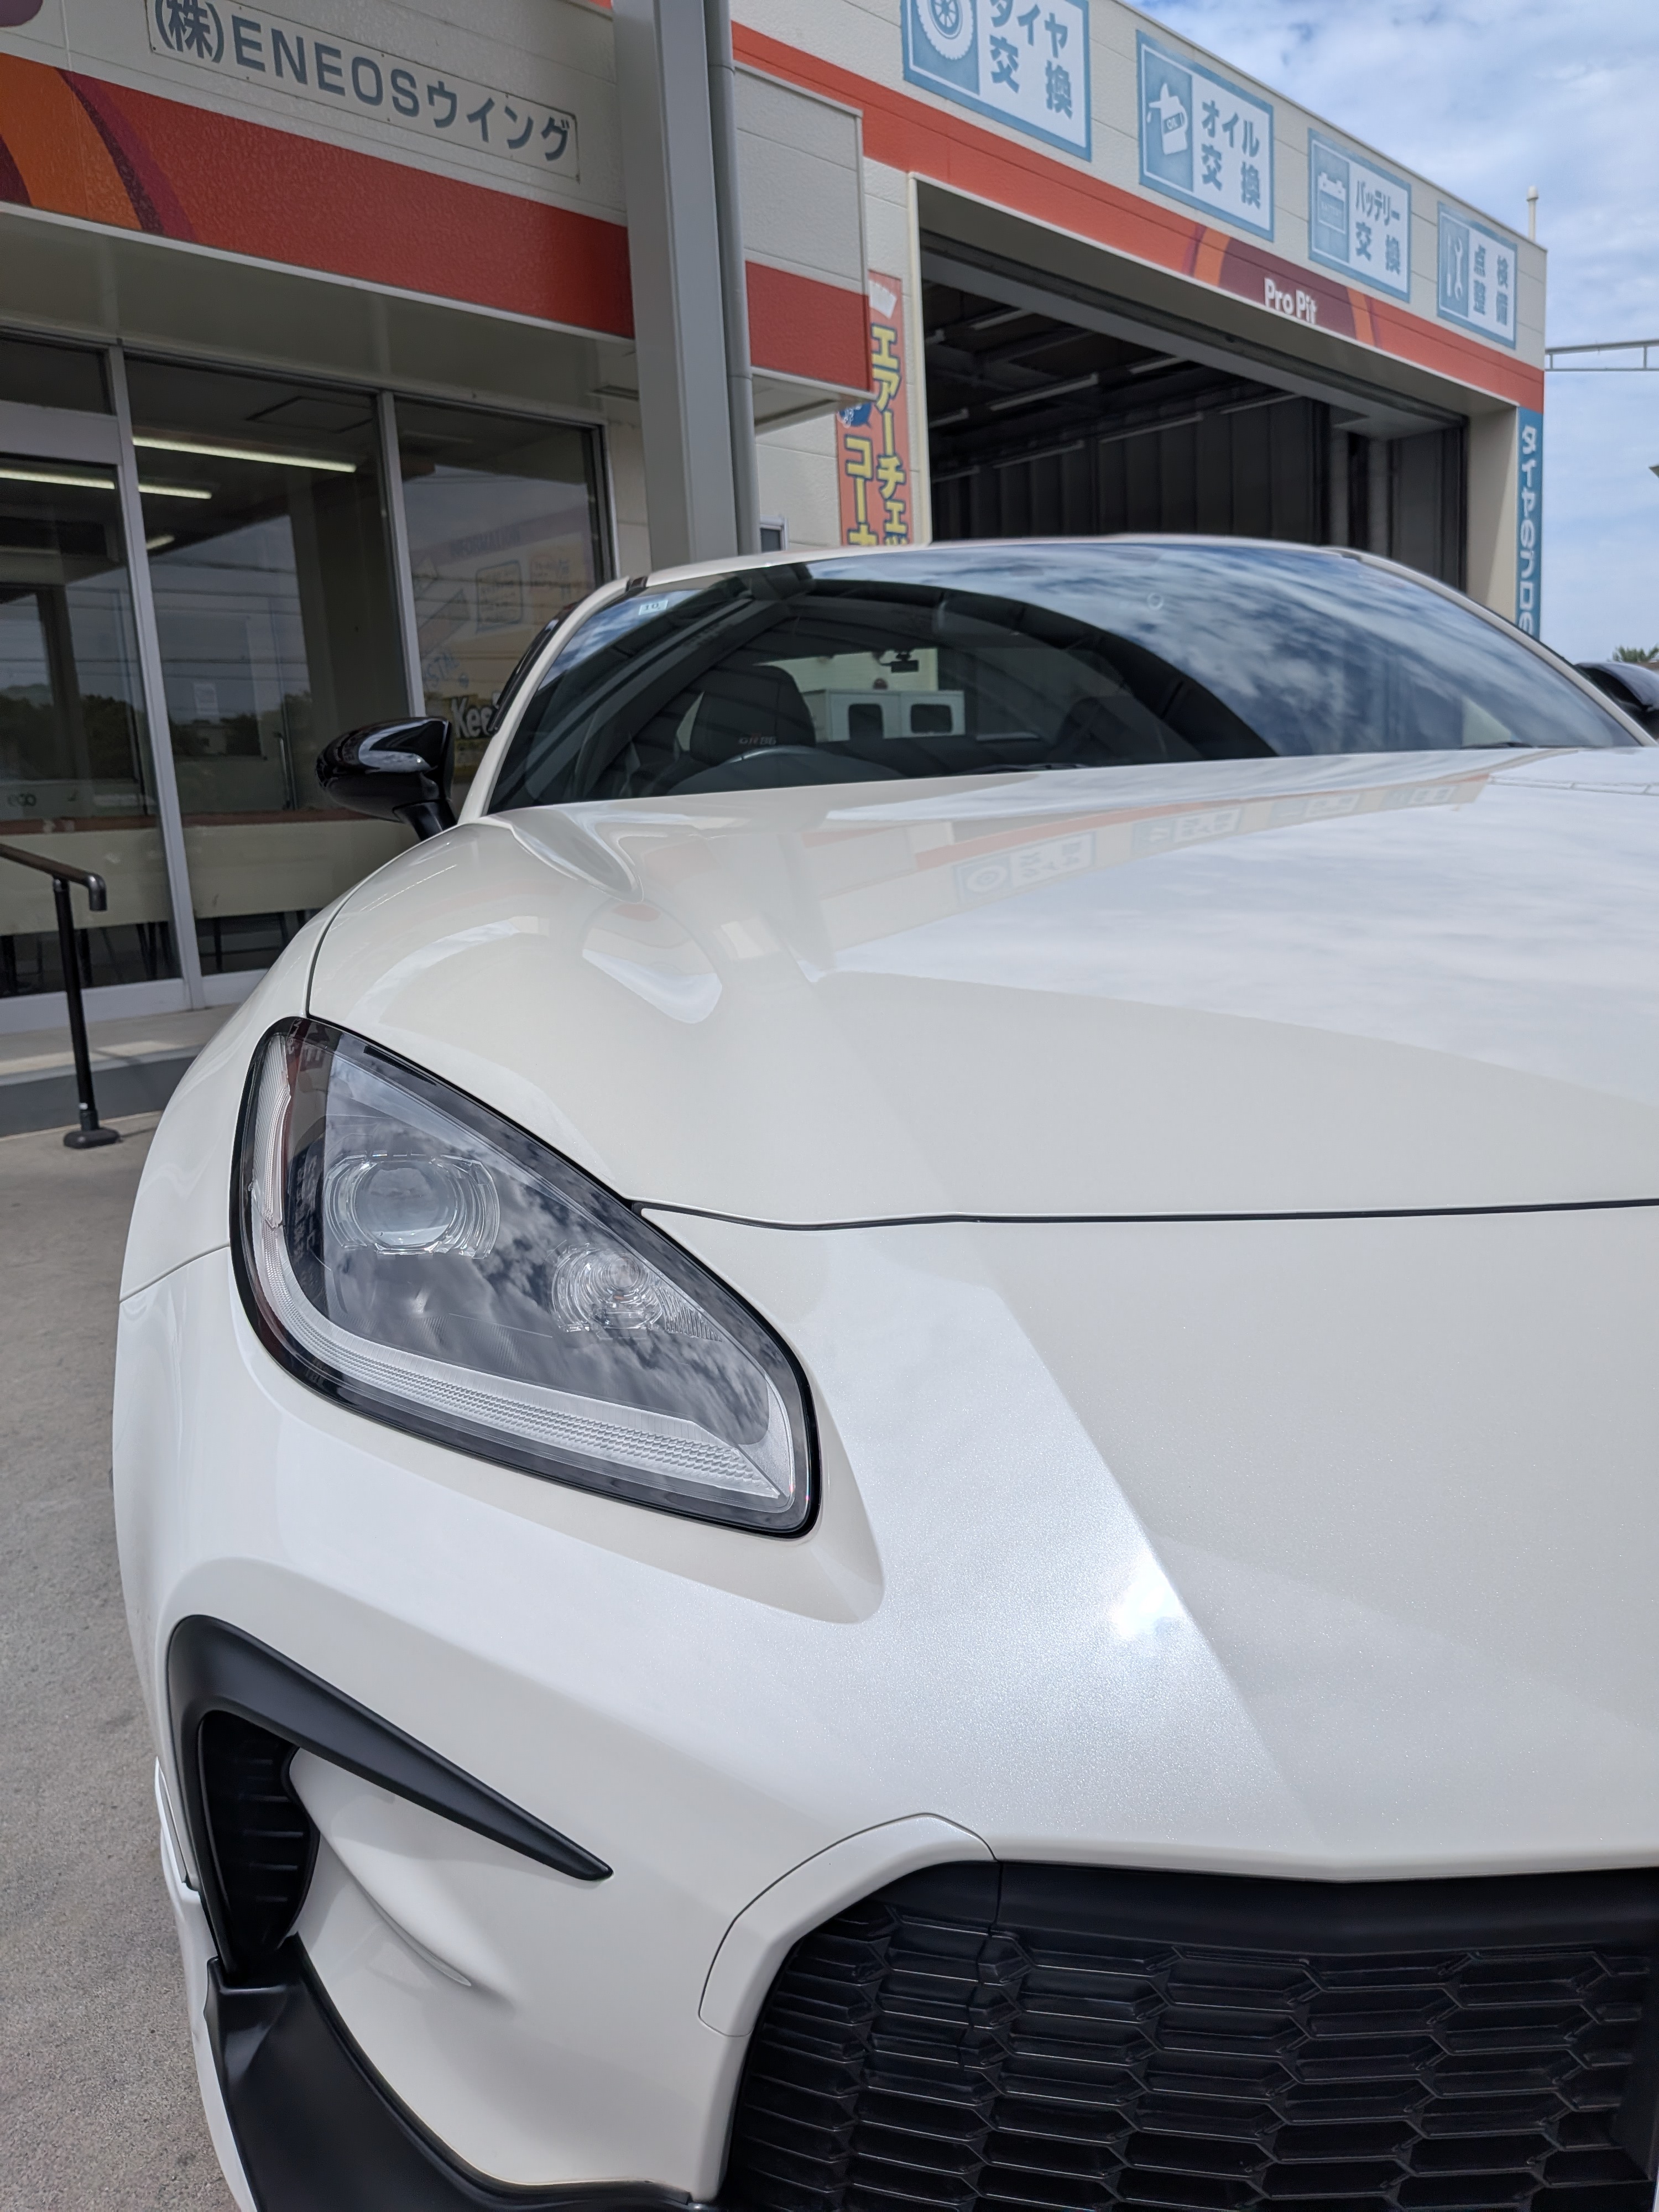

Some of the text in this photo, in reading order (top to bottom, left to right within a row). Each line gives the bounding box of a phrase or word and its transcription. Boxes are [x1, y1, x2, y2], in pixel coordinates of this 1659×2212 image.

[155, 0, 570, 162] (株)ENEOSウイング
[989, 34, 1073, 119] 交換
[1201, 100, 1260, 158] オイル
[1201, 143, 1261, 210] 交換
[1355, 180, 1400, 226] バッテリー
[1355, 221, 1400, 275] 交換
[1264, 277, 1317, 324] Pro Pit
